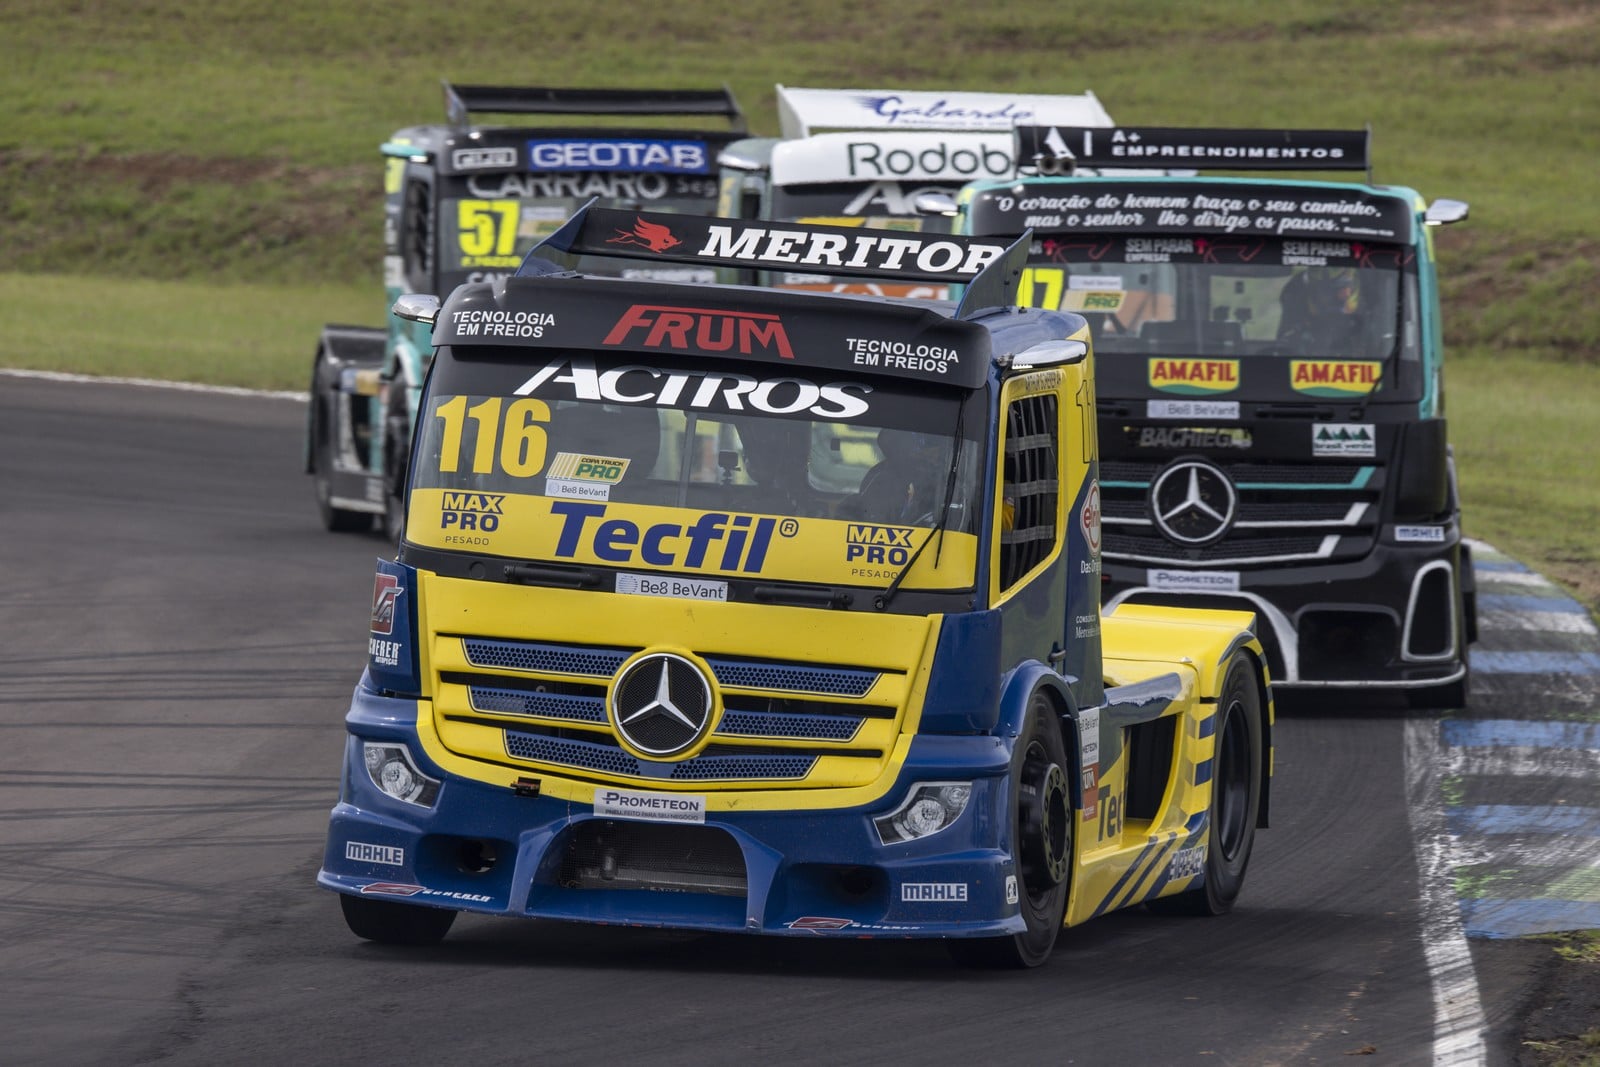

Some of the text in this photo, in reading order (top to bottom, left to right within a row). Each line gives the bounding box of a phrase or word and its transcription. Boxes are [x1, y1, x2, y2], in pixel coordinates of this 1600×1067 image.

[873, 97, 1032, 123] Gabardo
[1111, 131, 1140, 143] A+
[532, 144, 705, 168] GEOTAB
[848, 143, 1010, 175] Rodob
[1112, 146, 1344, 158] EMPREENDIMENTOS
[468, 175, 667, 199] CARRARO
[1019, 196, 1092, 212] coração
[1095, 194, 1121, 209] do
[1124, 194, 1191, 209] homem
[1192, 195, 1245, 216] traça
[1247, 202, 1261, 211] o
[1263, 202, 1298, 212] seu
[458, 199, 520, 256] 57
[1024, 214, 1063, 227] mas
[1066, 215, 1081, 225] o
[1083, 210, 1145, 227] senhor
[1157, 210, 1188, 226] lhe
[1193, 211, 1251, 233] dirige
[1255, 217, 1275, 229] os
[698, 224, 1005, 275] MERITOR
[1126, 239, 1195, 254] SEM PARAR
[1282, 241, 1308, 255] SEM
[452, 311, 556, 326] TECNOLOGIA
[457, 323, 544, 338] EM FREIOS
[603, 304, 796, 359] FRUM
[845, 338, 960, 362] TECNOLOGIA
[852, 351, 948, 373] EM FREIOS
[1152, 361, 1236, 381] AMAFIL
[1293, 362, 1376, 383] AMAFIL
[514, 360, 873, 418] ACTROS
[436, 395, 551, 477] 116
[575, 464, 622, 480] PRO
[561, 485, 607, 497] Be8 BeVant
[442, 492, 505, 514] MAX
[441, 512, 499, 532] PRO
[445, 536, 490, 546] PESADO
[549, 501, 778, 574] Tecfil
[847, 525, 914, 548] MAX
[1398, 528, 1442, 538] MAHLE
[846, 545, 909, 566] PRO
[851, 569, 900, 580] PESADO
[1155, 573, 1233, 585] PROMETEON
[640, 580, 725, 600] Be8 BeVant
[602, 792, 700, 812] PROMETEON
[348, 844, 402, 864] MAHLE
[904, 885, 966, 900] MAHLE
